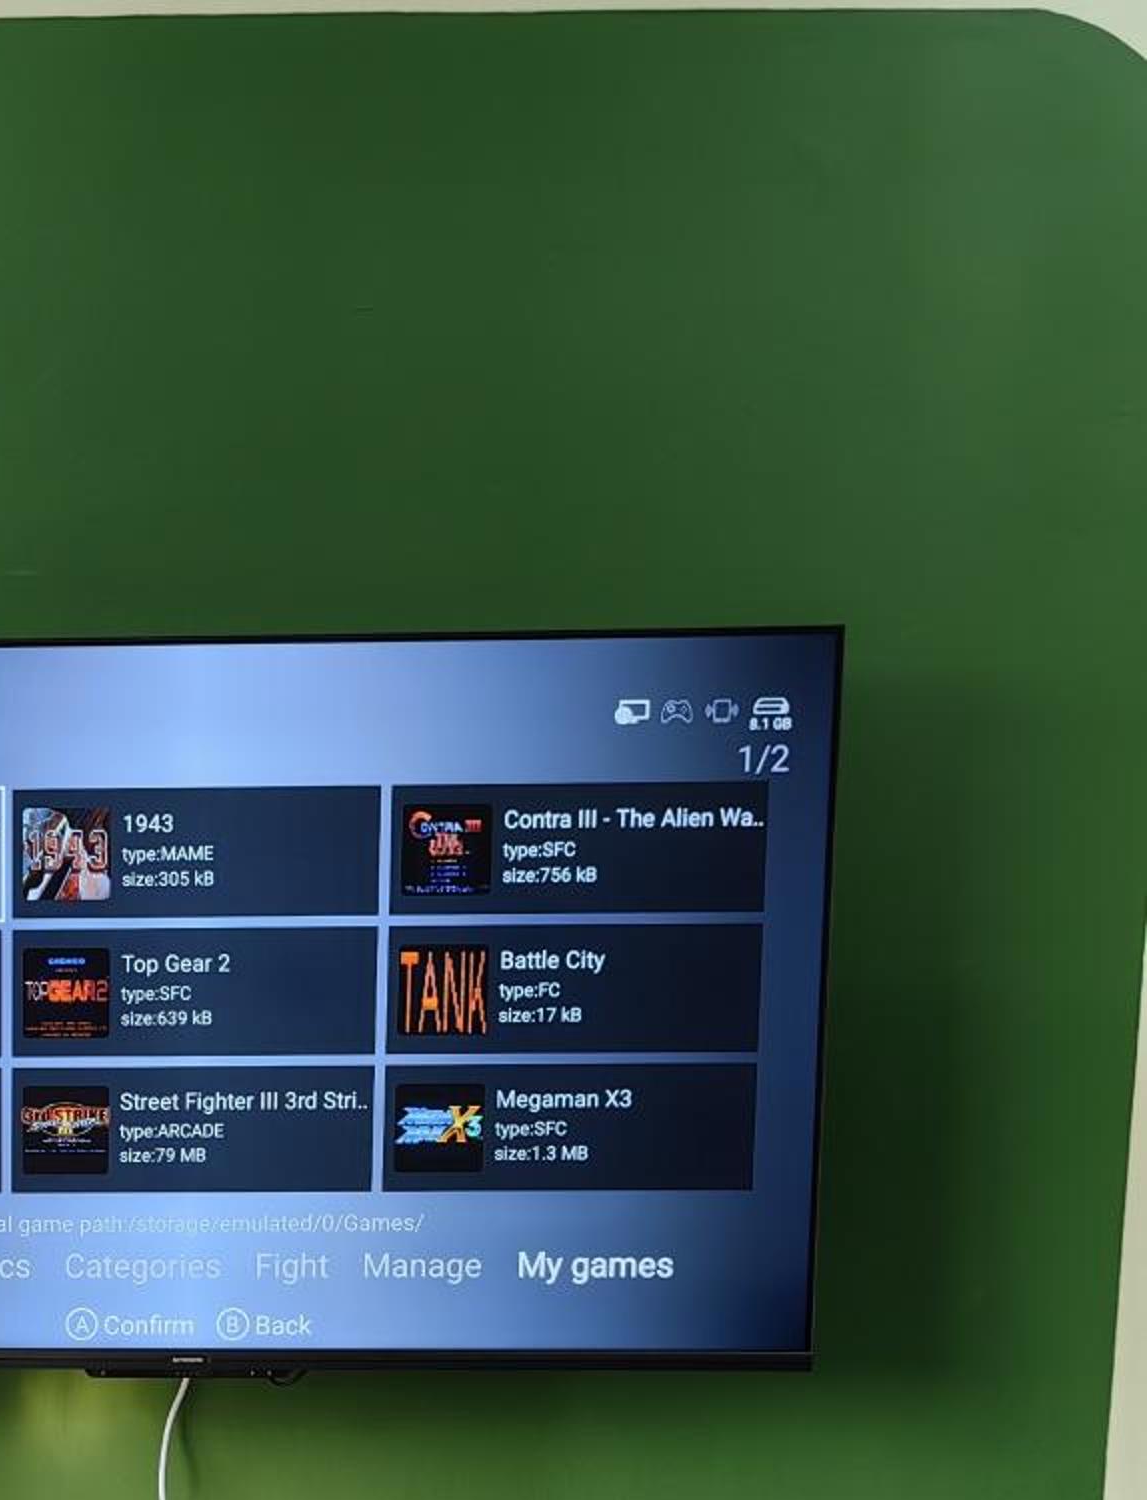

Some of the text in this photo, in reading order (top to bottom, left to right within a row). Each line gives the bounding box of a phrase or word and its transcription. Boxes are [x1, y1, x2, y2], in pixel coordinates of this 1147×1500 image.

[738, 743, 790, 775] 1/2
[124, 813, 175, 832] 1943
[504, 809, 572, 829] Contra
[578, 808, 598, 828] III
[616, 808, 657, 828] The
[661, 807, 715, 828] Alien
[28, 828, 109, 872] 1943
[122, 846, 215, 866] type:MAME
[503, 841, 577, 862] type:SFC
[122, 869, 215, 887] size:305 kB
[503, 865, 598, 884] size:756 kB
[122, 953, 231, 978] Top Gear 2
[501, 950, 606, 975] Battle City
[121, 984, 192, 1005] type:SFC
[400, 951, 486, 1035] TANK
[500, 981, 561, 1002] type:FC
[121, 1008, 213, 1027] size:639 kB
[499, 1006, 582, 1024] size:17 kB
[120, 1092, 180, 1112] Street
[185, 1091, 254, 1117] Fighter
[260, 1091, 279, 1110] III
[284, 1091, 318, 1110] 3rd
[496, 1089, 633, 1113] Megaman X3
[120, 1122, 225, 1142] type:ARCADE
[495, 1119, 568, 1140] type:SFC
[120, 1146, 207, 1165] size:79 MB
[494, 1144, 589, 1162] size:1.3 MB
[18, 1220, 75, 1238] game
[65, 1252, 222, 1286] Categories
[256, 1251, 330, 1285] Fight
[364, 1253, 483, 1287] Manage
[517, 1251, 564, 1286] My
[572, 1258, 675, 1287] games
[104, 1313, 195, 1336] Confirm
[256, 1313, 312, 1336] Back
